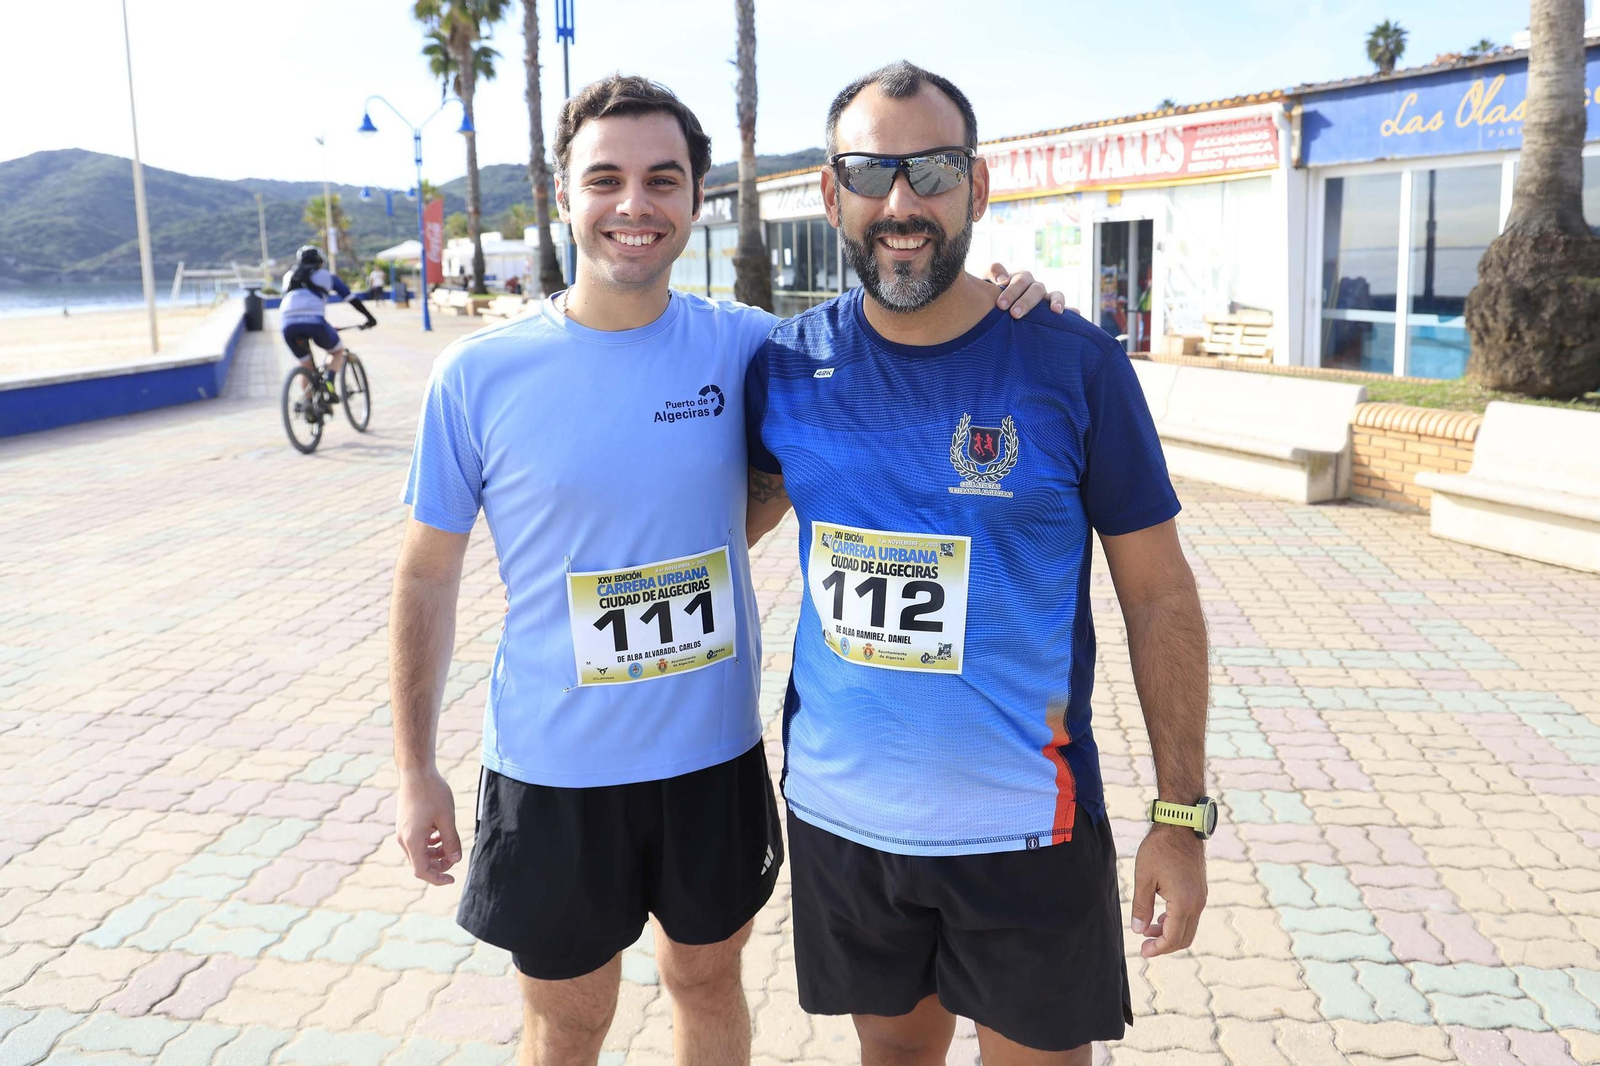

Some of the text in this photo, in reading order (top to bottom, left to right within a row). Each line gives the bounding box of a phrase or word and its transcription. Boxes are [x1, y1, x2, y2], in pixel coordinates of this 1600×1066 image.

[1380, 92, 1444, 137] Las
[1455, 73, 1527, 128] Olas
[665, 397, 708, 409] Puerto de
[654, 408, 710, 424] Algeciras
[834, 531, 864, 544] XXV EDICIÓN
[888, 538, 919, 547] NOVIEMBRE
[832, 540, 938, 565] CARRERA URBANA
[598, 571, 642, 584] XXV EDICIÓN
[831, 554, 939, 579] CIUDAD DE ALGECIRAS
[597, 566, 709, 597] CARRERA URBANA
[599, 578, 710, 609] CIUDAD DE ALGECIRAS
[822, 570, 945, 632] 112
[593, 591, 715, 652] 111
[836, 624, 912, 645] DE ALBA RAMIREZ, DANIEL
[617, 640, 702, 663] DE ALBA ALVARADO, CARLOS
